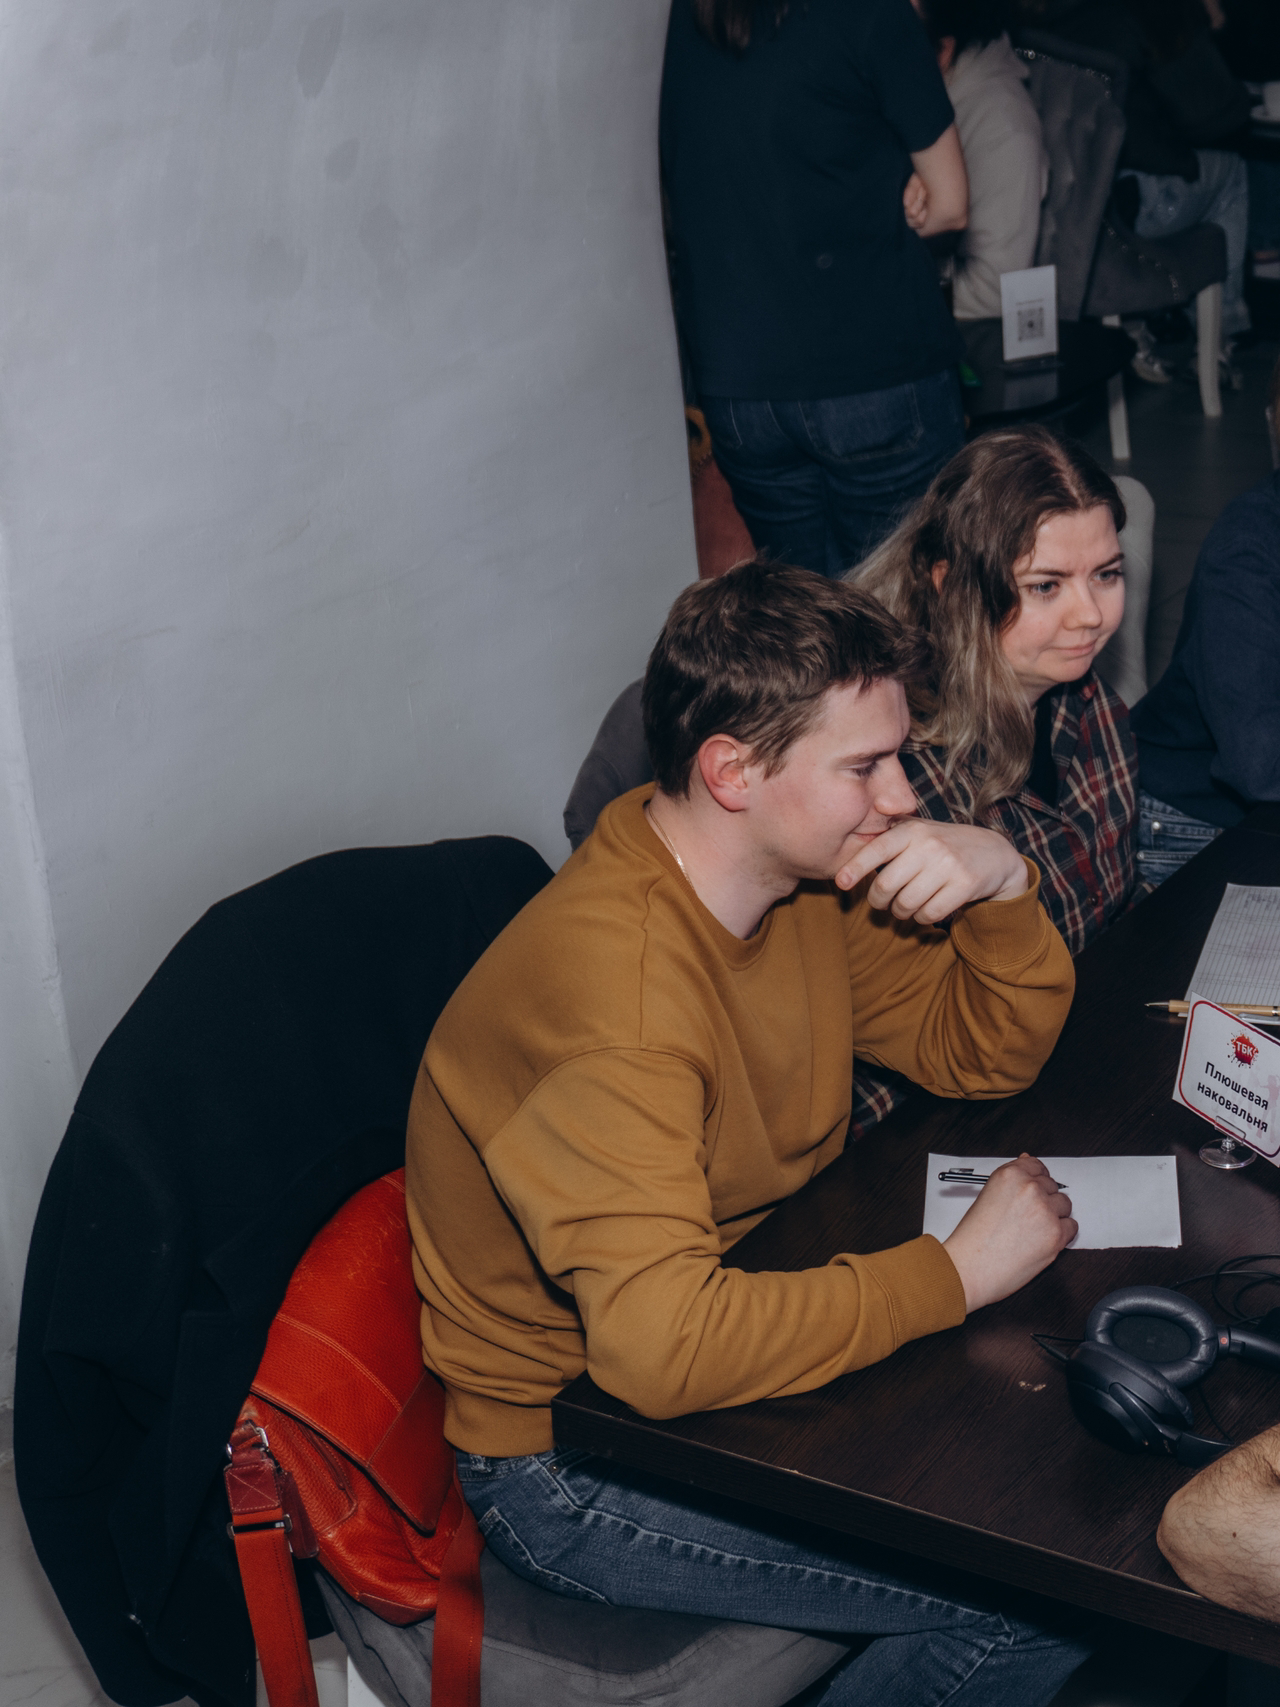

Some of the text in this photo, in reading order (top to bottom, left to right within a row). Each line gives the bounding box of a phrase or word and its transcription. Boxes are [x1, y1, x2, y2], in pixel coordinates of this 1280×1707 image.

[1235, 1040, 1254, 1057] ТБК
[1197, 1081, 1269, 1133] наковальня
[1205, 1061, 1269, 1110] Плюшевая
